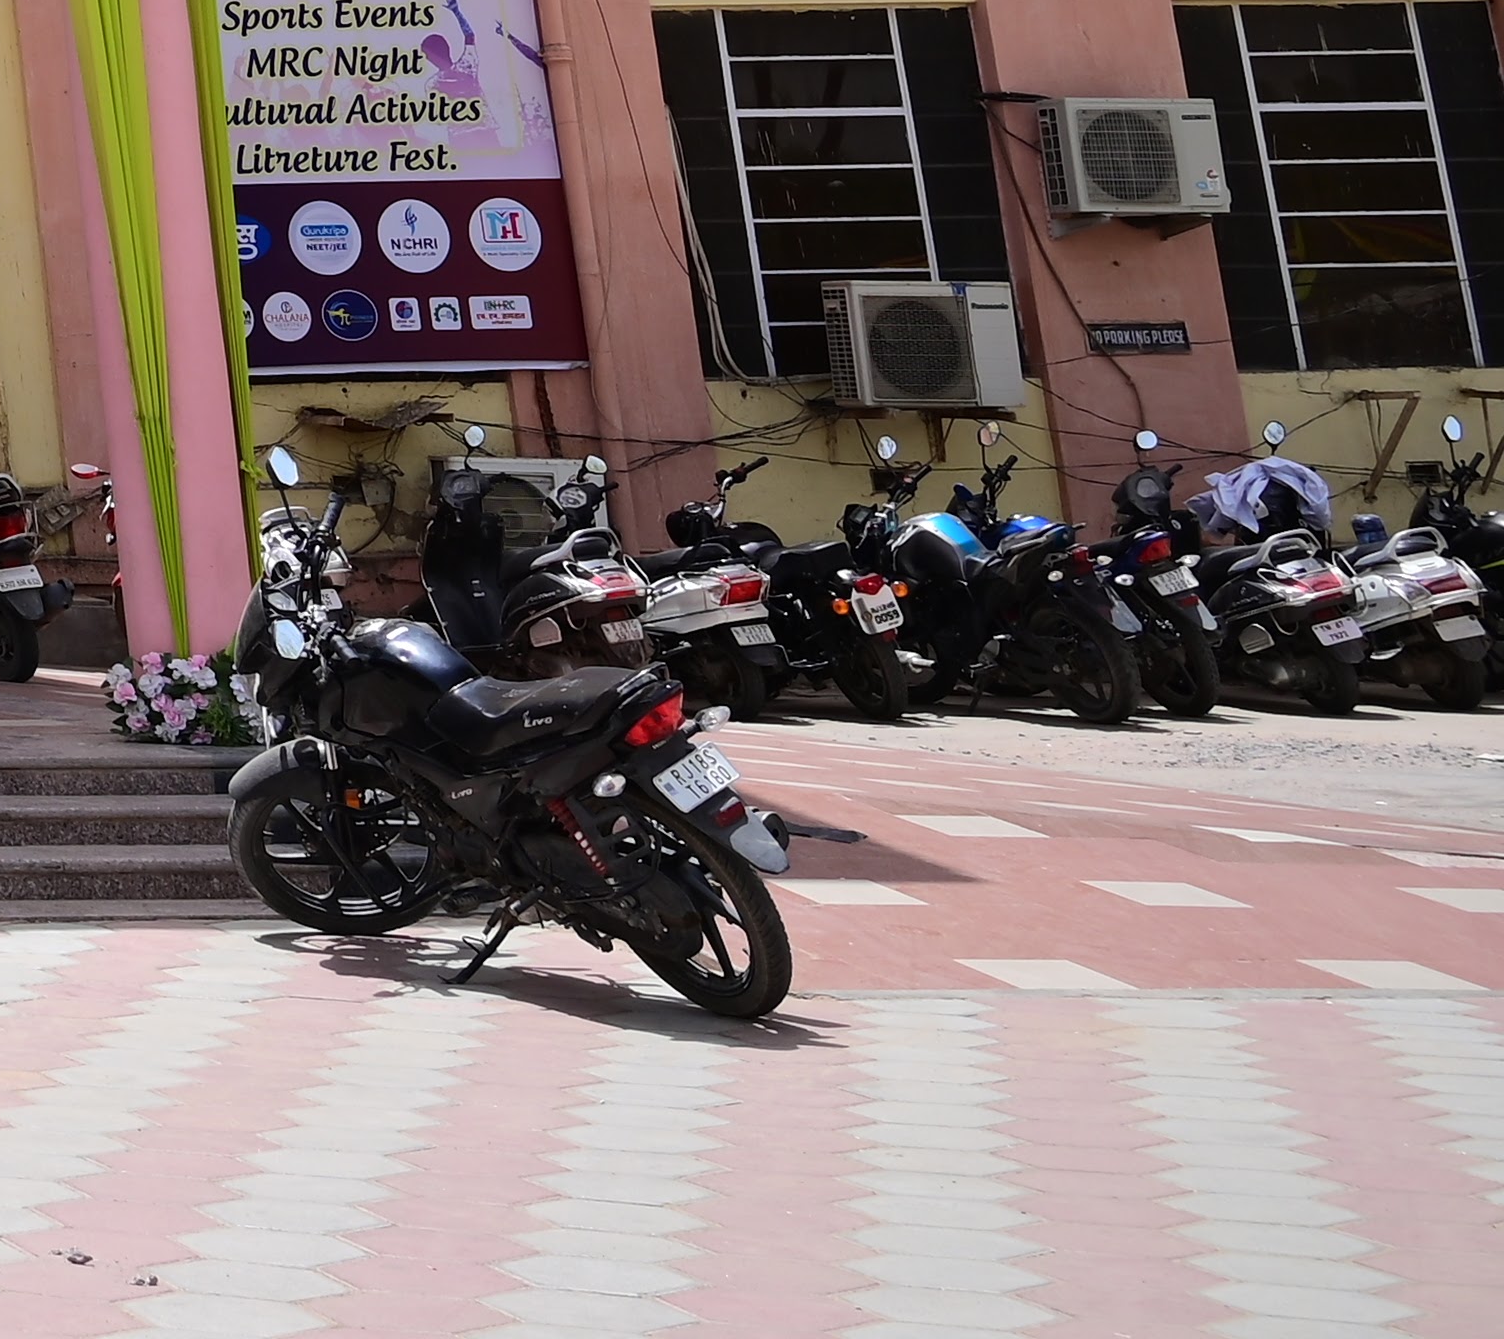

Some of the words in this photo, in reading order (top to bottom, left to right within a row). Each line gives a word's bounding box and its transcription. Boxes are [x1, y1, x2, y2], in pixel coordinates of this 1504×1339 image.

[221, 0, 324, 33] Sports
[334, 0, 435, 29] Events
[246, 47, 325, 78] MRC
[333, 45, 424, 84] Night
[226, 94, 337, 124] ultural
[345, 91, 483, 124] Activites
[236, 143, 378, 175] Litreture
[388, 139, 458, 172] Fest.
[265, 313, 310, 323] CHALANA
[1103, 329, 1151, 345] PARKING
[1151, 329, 1186, 344] PLEASE
[670, 748, 718, 787] RJ18S
[685, 765, 732, 800] T6180
